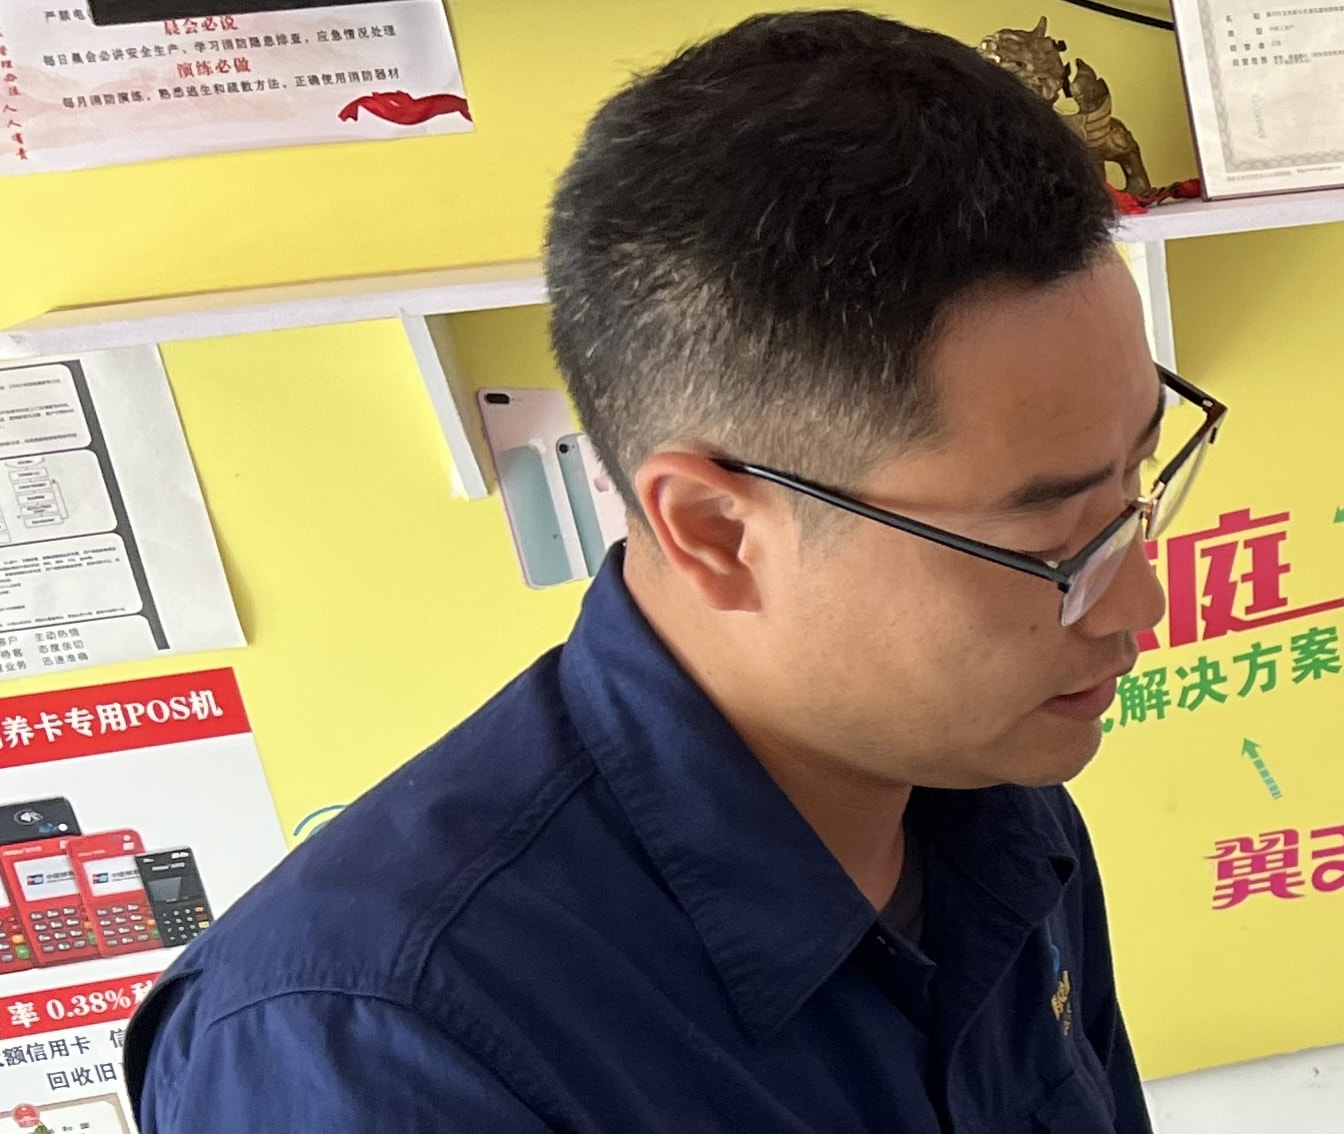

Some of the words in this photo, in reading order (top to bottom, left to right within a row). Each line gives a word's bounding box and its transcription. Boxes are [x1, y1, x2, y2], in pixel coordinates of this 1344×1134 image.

[43, 9, 90, 22] 严禁电
[164, 16, 238, 36] 晨会必说
[176, 57, 251, 79] 演练必做
[1102, 626, 1344, 735] 解决方案
[0, 689, 223, 750] 养卡专用POS机
[7, 1001, 41, 1029] 率
[0, 1036, 91, 1069] 额信用卡
[46, 1062, 123, 1091] 回收旧
